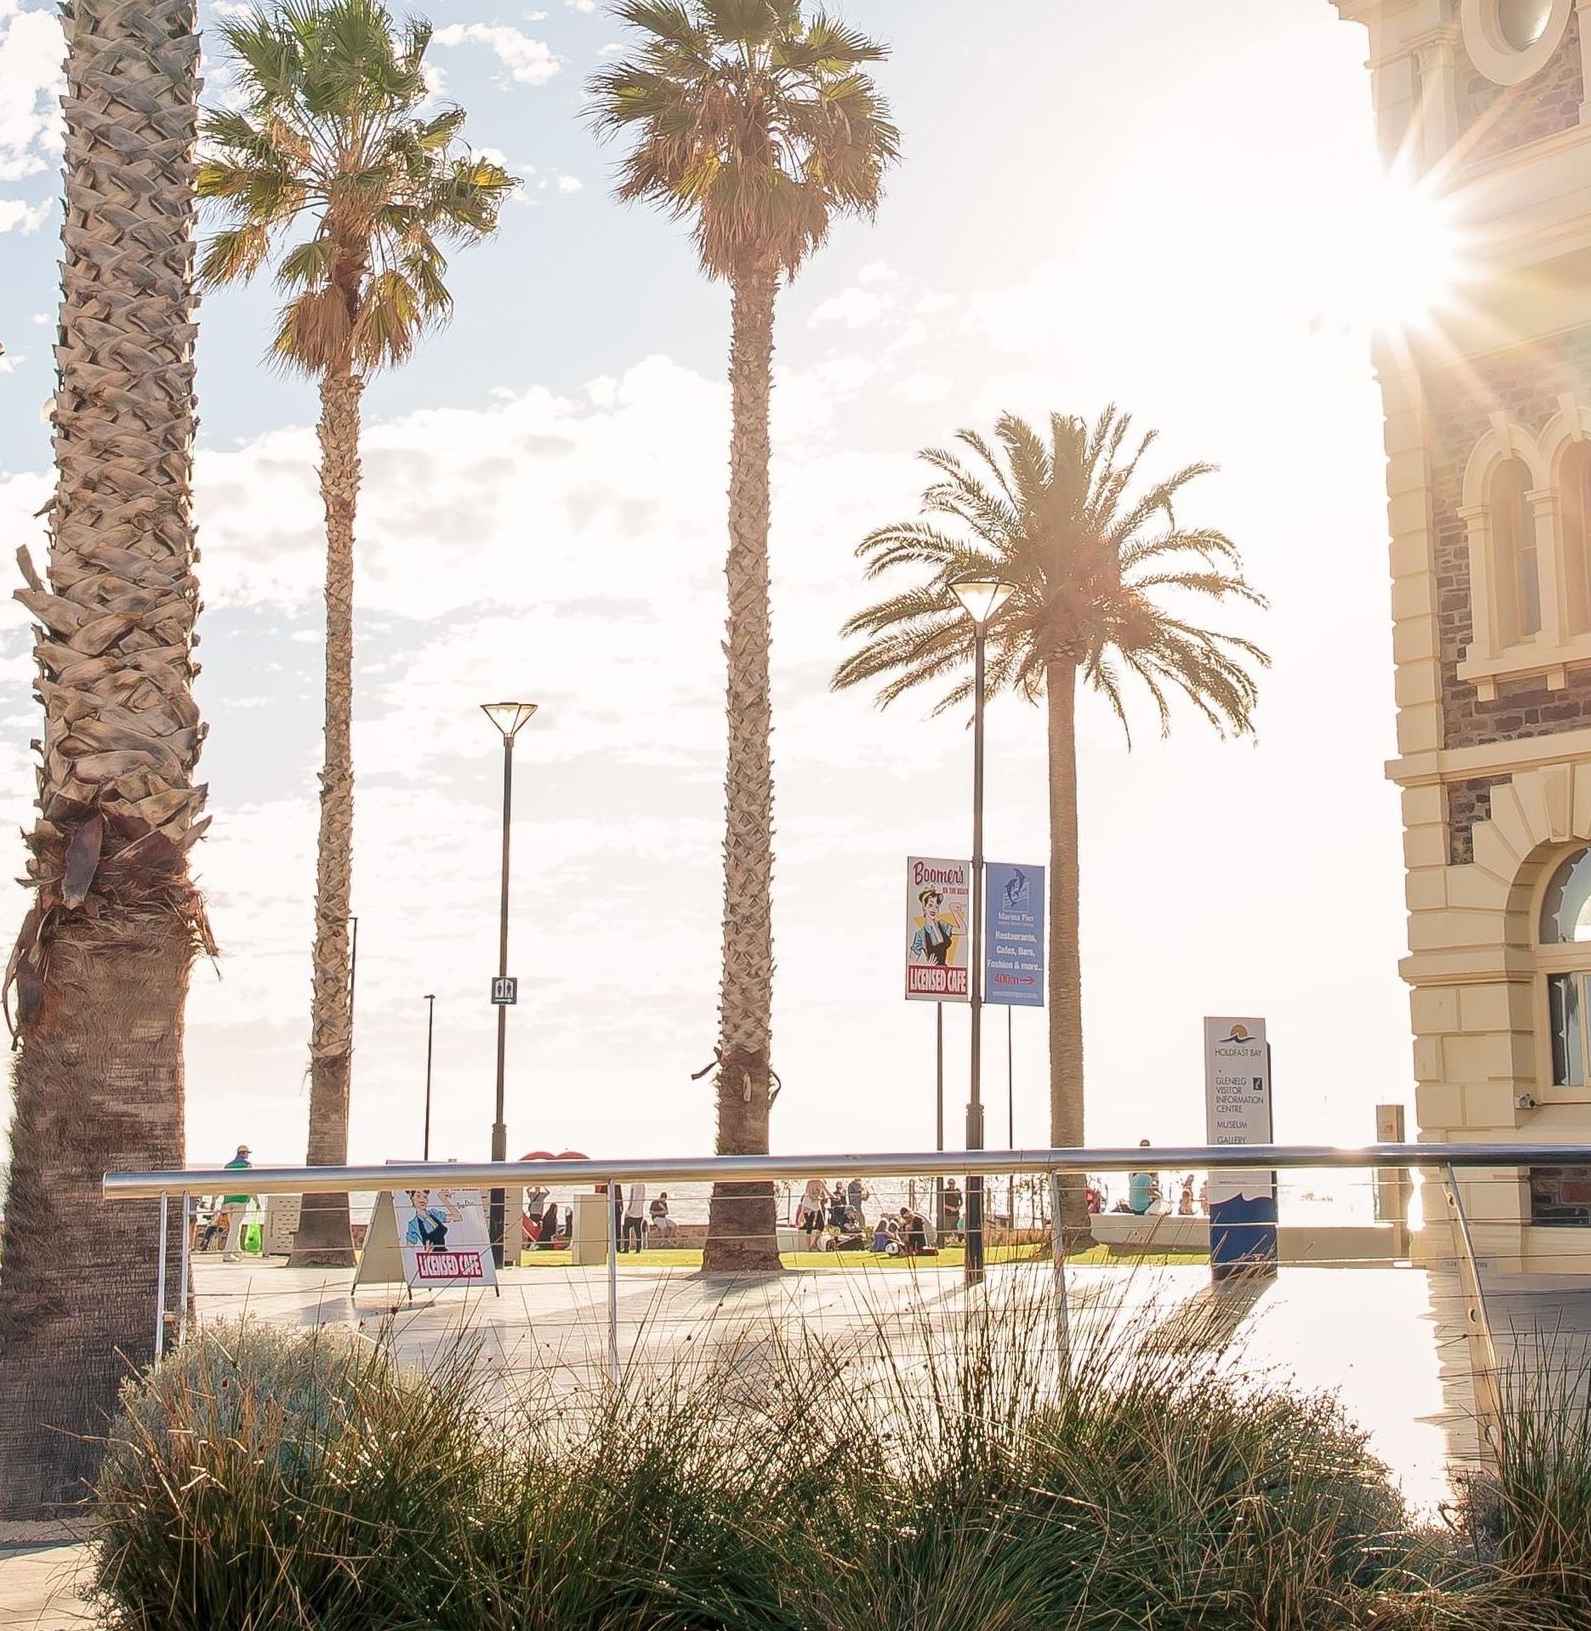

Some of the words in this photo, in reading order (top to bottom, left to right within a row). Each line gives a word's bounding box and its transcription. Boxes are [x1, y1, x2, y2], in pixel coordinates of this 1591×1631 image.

[913, 861, 964, 886] Boomer's
[910, 968, 947, 991] LICENSED
[947, 969, 966, 992] CAFE
[1214, 1048, 1248, 1057] HOLDFAST
[1250, 1048, 1262, 1057] BAY
[1215, 1077, 1247, 1086] GLENELG
[1215, 1086, 1242, 1094] VISITOR
[1216, 1096, 1264, 1105] INFORMATION
[1216, 1105, 1243, 1113] CENTRE
[1217, 1120, 1247, 1129] MUSEUM
[1217, 1135, 1247, 1144] GALLERY
[419, 1255, 459, 1276] LICENSED
